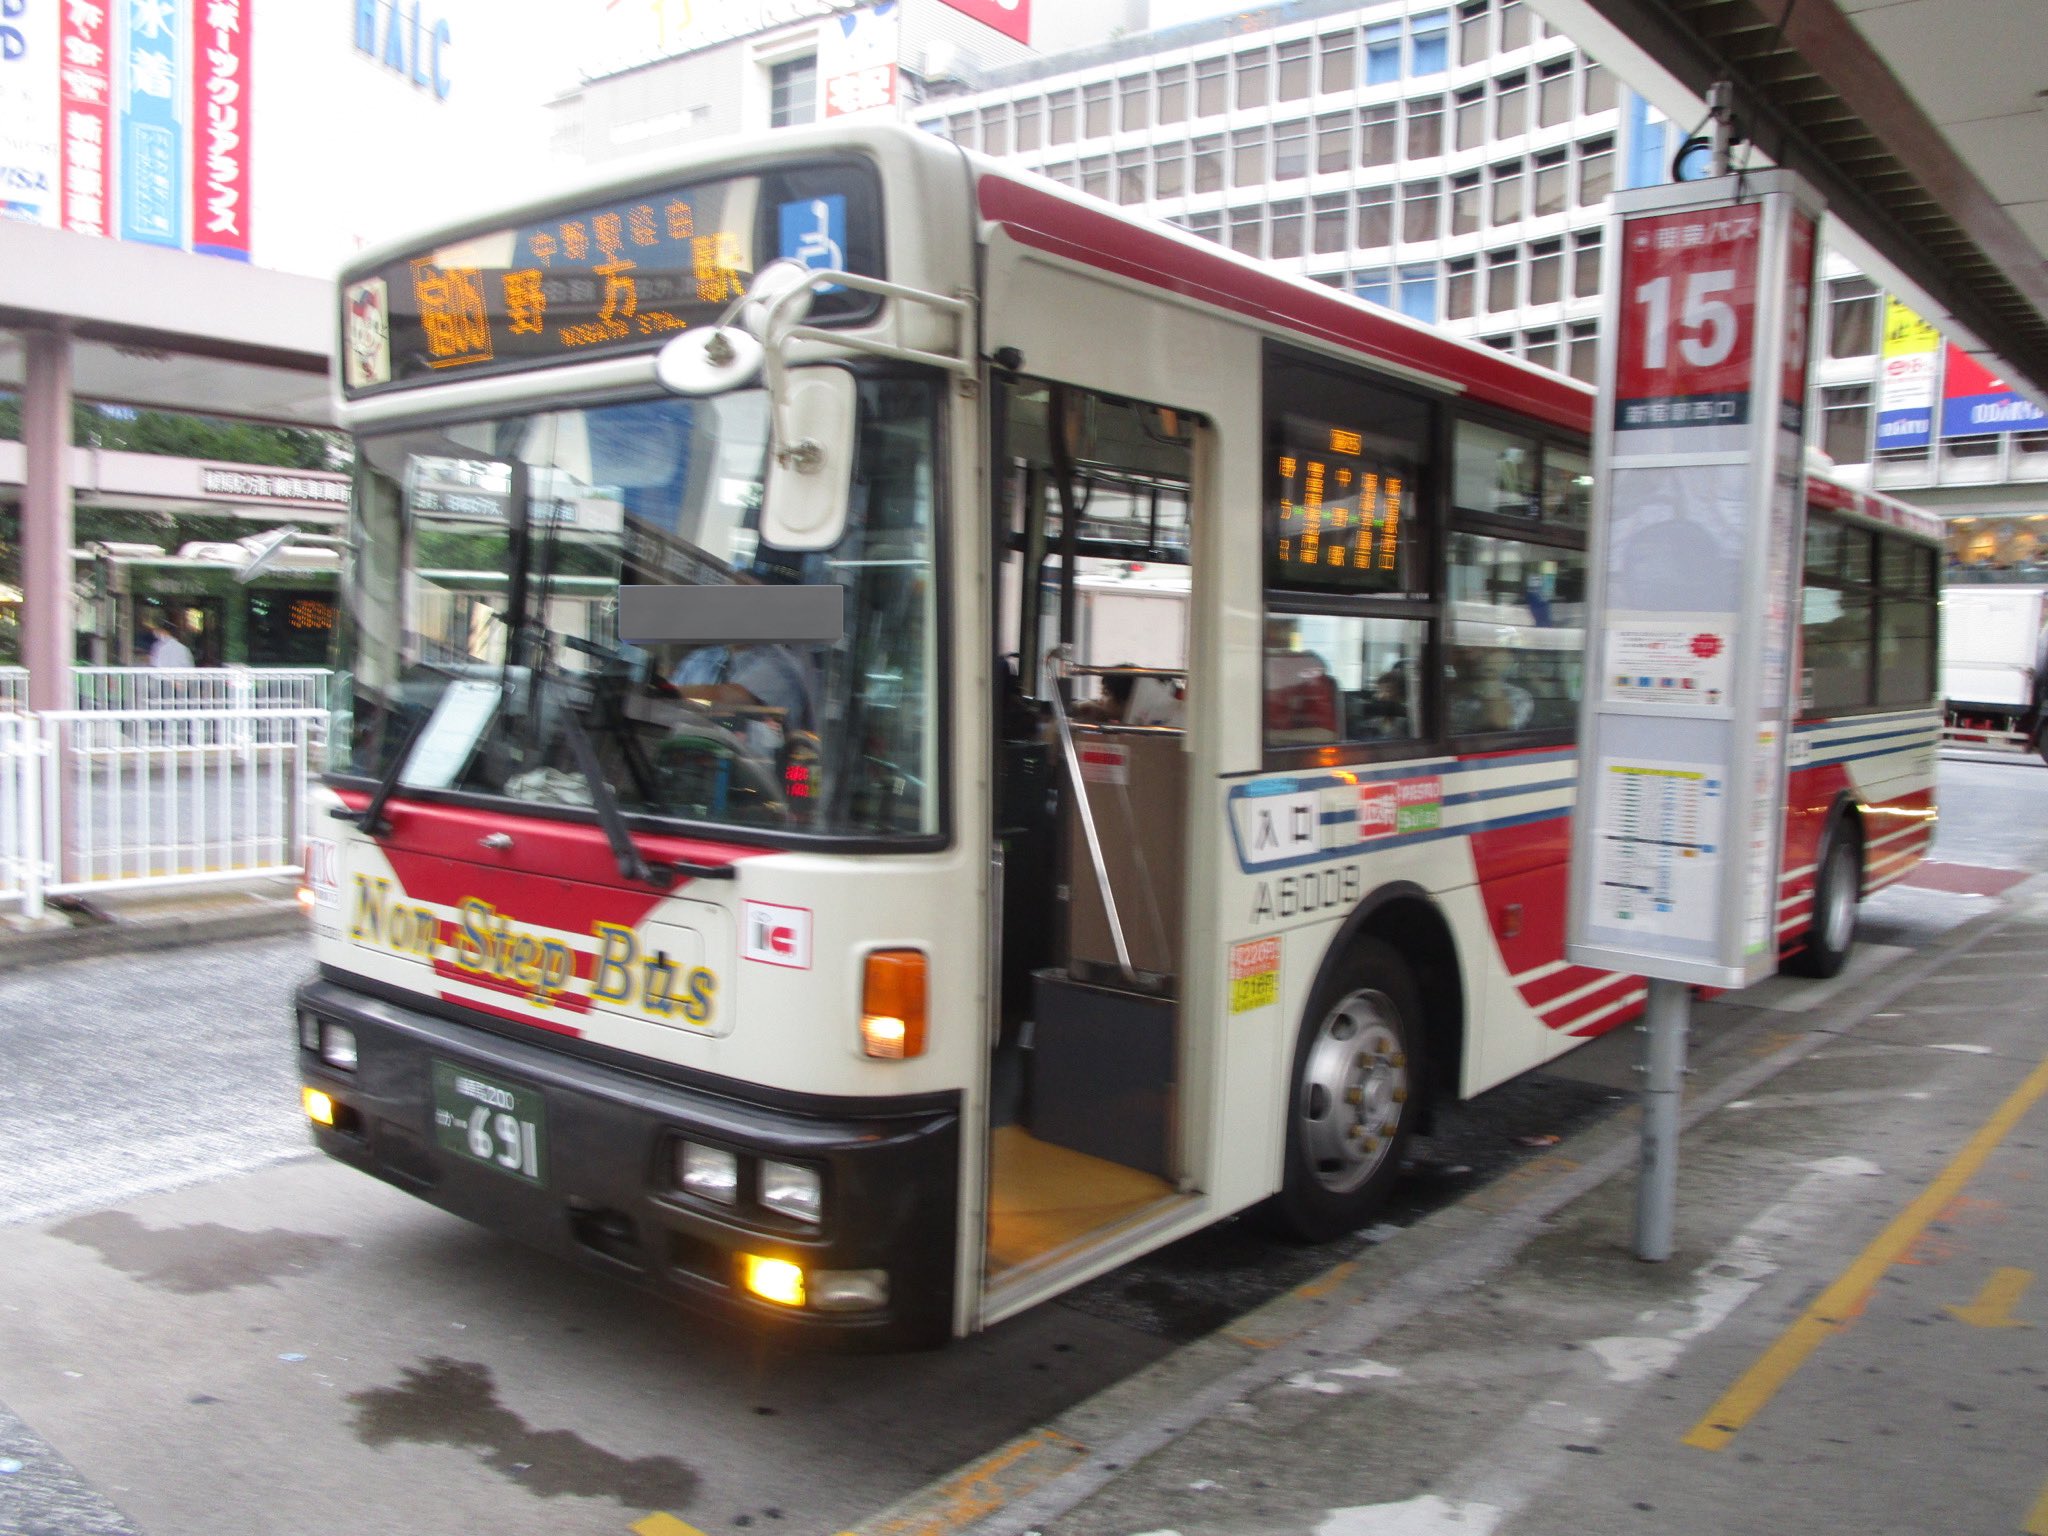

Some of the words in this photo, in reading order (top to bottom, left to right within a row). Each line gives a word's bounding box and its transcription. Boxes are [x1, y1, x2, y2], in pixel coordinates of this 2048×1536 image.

[1635, 268, 1738, 368] 15
[1254, 803, 1313, 850] 入口
[346, 873, 445, 960] Non
[454, 895, 577, 1008] Step
[589, 919, 720, 1026] Bus
[467, 1104, 538, 1178] 691
